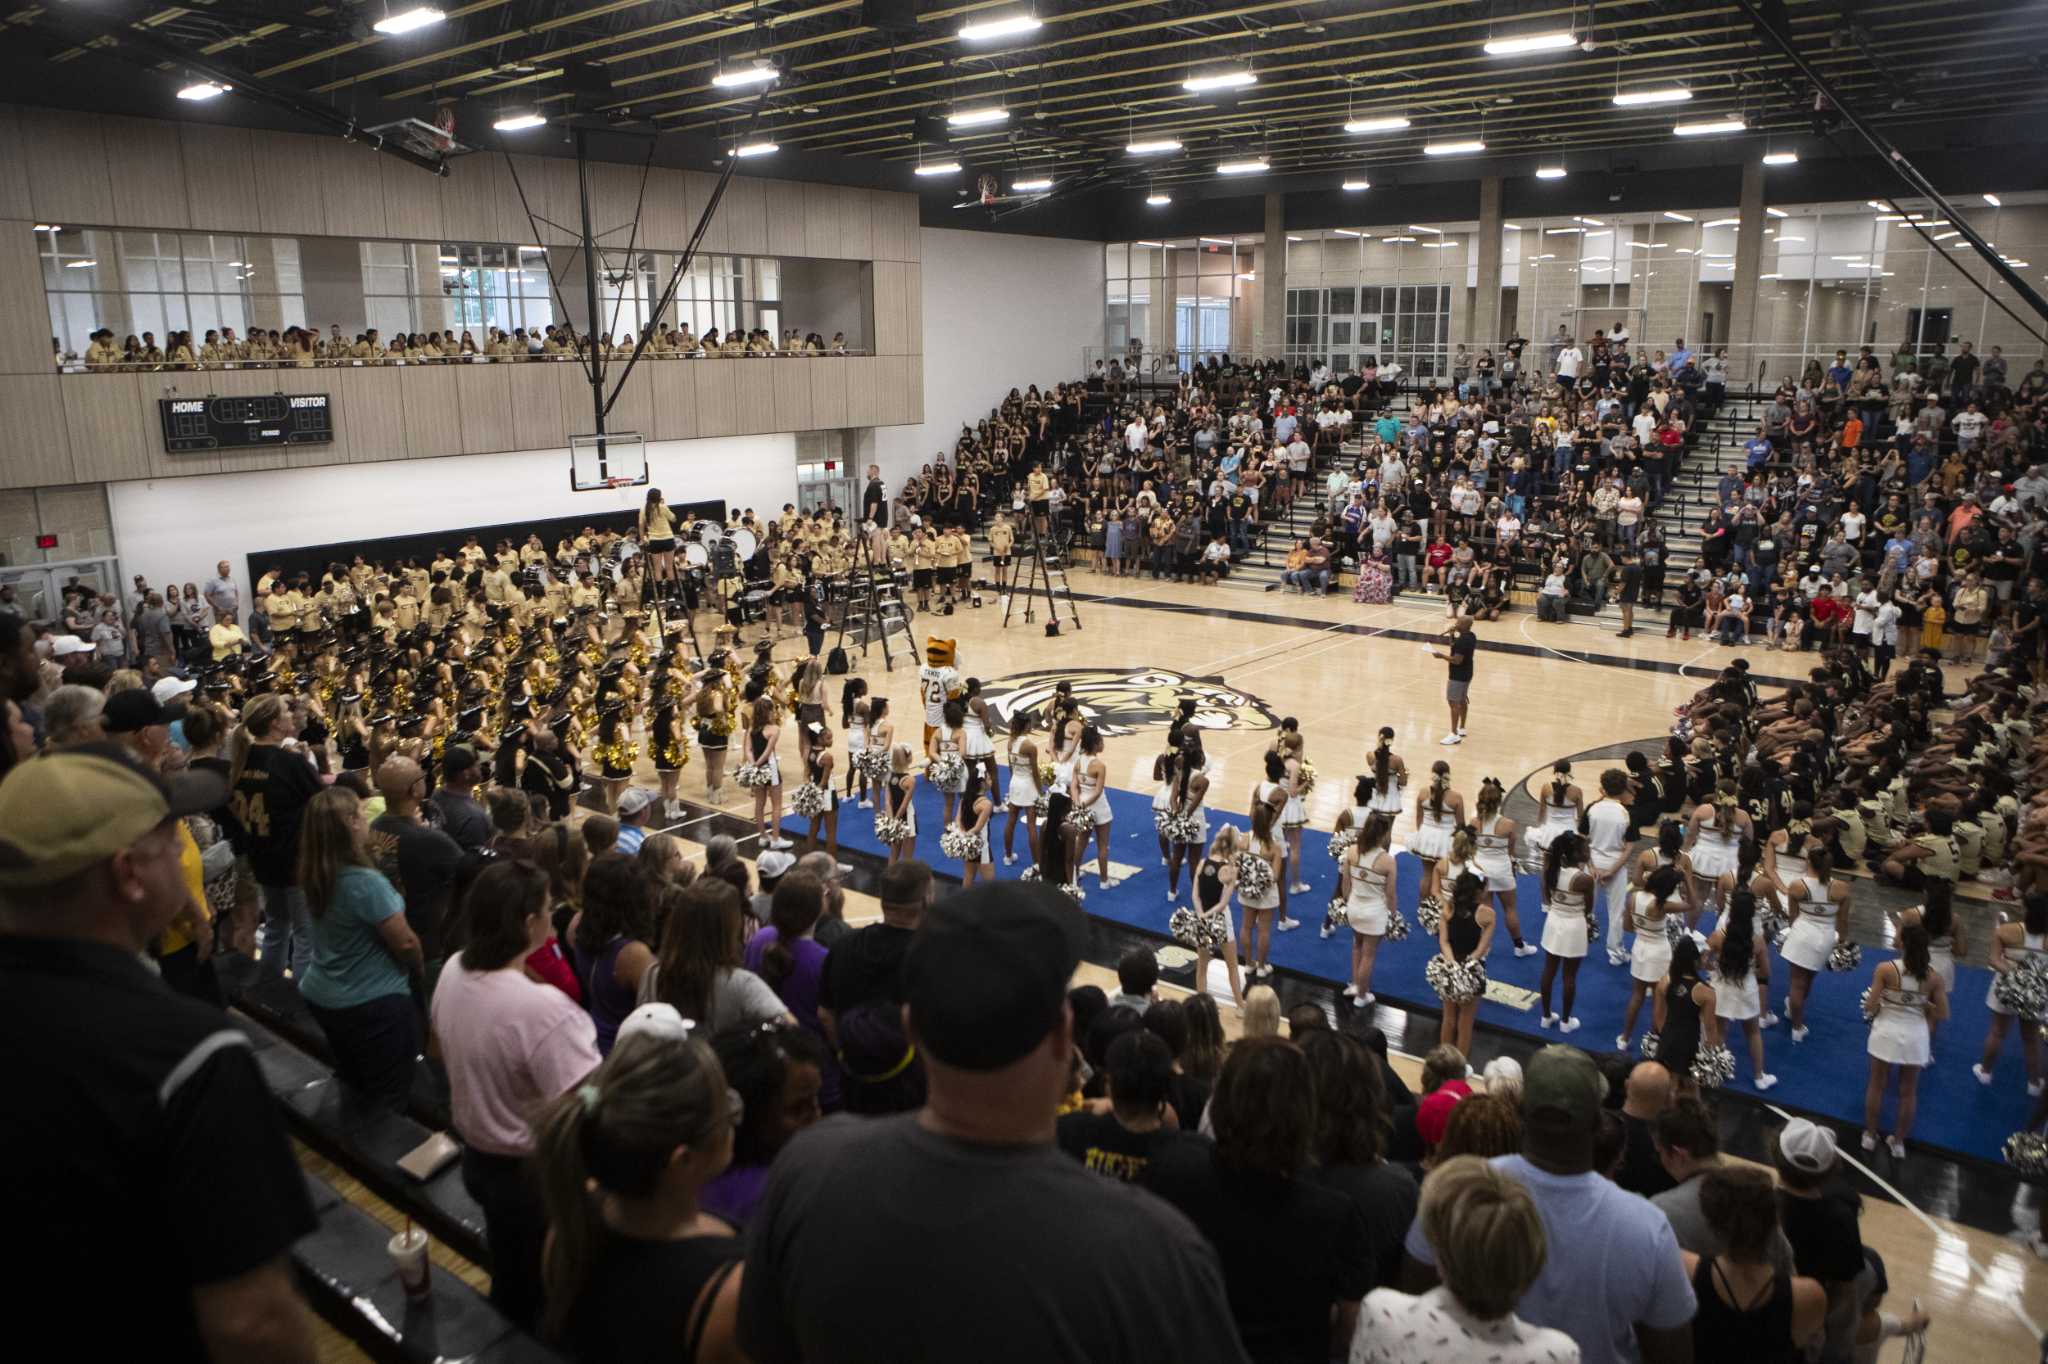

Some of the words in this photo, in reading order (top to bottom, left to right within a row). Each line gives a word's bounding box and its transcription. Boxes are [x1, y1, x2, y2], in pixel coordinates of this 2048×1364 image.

[172, 401, 204, 413] HOME
[290, 397, 326, 409] VISITOR
[921, 678, 941, 703] 72
